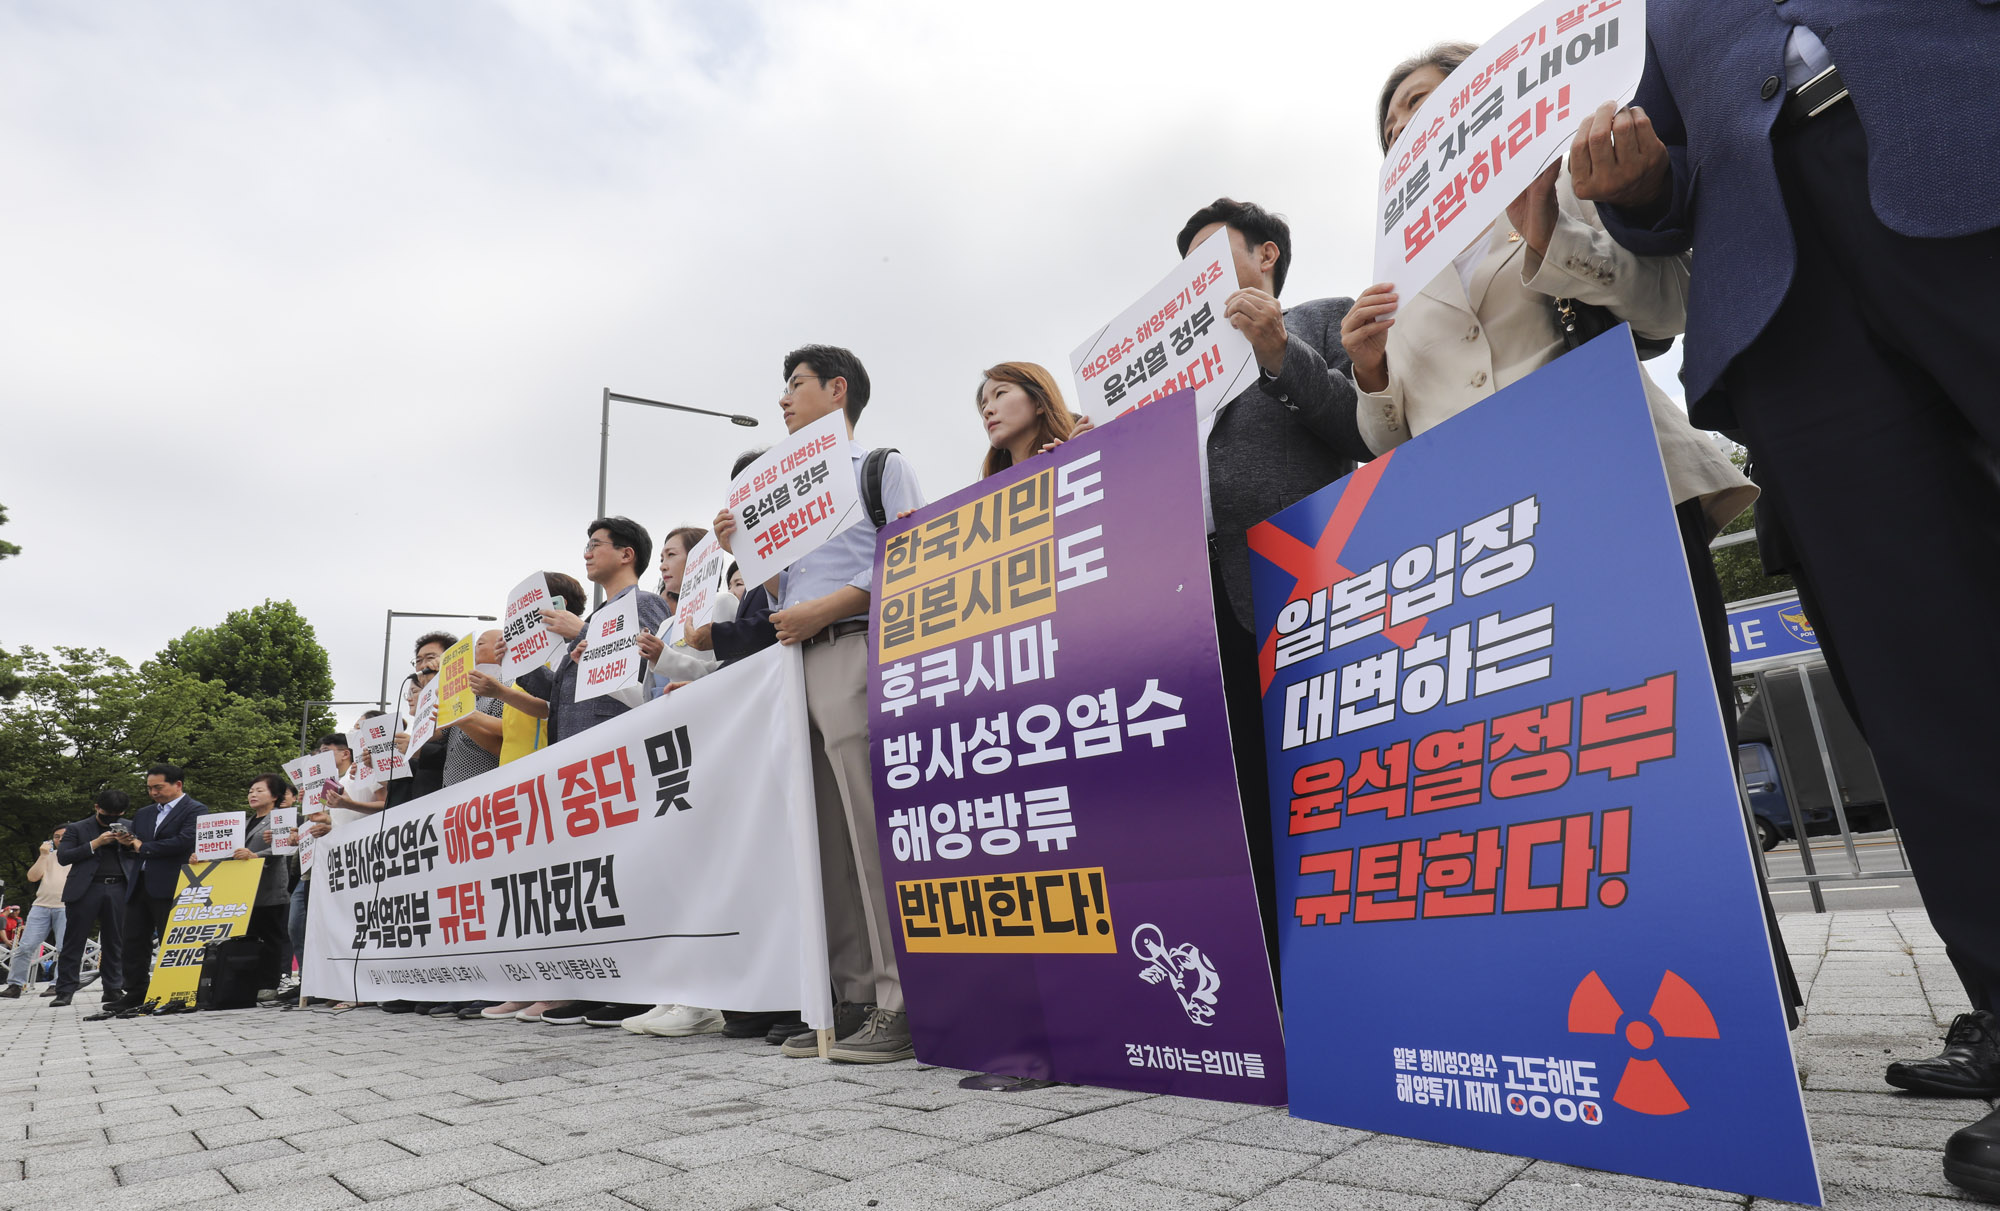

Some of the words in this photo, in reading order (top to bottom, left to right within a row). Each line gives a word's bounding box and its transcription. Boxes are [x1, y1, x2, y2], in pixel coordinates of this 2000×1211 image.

[1384, 116, 1445, 195] 핵오염수
[1450, 25, 1546, 118] 해양투기
[1384, 159, 1431, 236] 일본
[1438, 85, 1504, 172] 자국
[1517, 17, 1620, 99] 내에
[1403, 84, 1572, 264] 보관하라!
[1081, 336, 1135, 391] 핵오염수
[1135, 287, 1192, 344] 해양투기
[1192, 260, 1224, 296] 방조
[1103, 341, 1169, 407] 윤석열
[1169, 301, 1215, 356] 정부
[1115, 344, 1224, 420] 한다!
[729, 482, 751, 509] 일본
[753, 465, 777, 494] 입장
[780, 433, 837, 474] 대변하는
[742, 483, 791, 530] 윤석열
[793, 460, 830, 496] 정부
[754, 491, 835, 560] 규탄한다!
[886, 450, 1104, 585] 한국시민도
[517, 589, 543, 610] 대변하는
[881, 524, 1108, 650] 일본시민도
[1273, 493, 1541, 672] 일본입장
[503, 617, 526, 642] 윤석열
[524, 607, 543, 629] 정부
[510, 630, 549, 664] 규탄한다!
[601, 614, 624, 637] 일본을
[587, 658, 627, 685] 제소하라!
[880, 618, 1059, 717] 후쿠시마
[1281, 603, 1555, 752] 대변하는
[883, 678, 1187, 790] 방사성오염수
[1287, 670, 1678, 837] 윤석열정부
[198, 840, 232, 854] 규탄한다!
[215, 828, 233, 839] 정부
[327, 846, 344, 893] 일본
[344, 813, 439, 889] 방사성오염수
[443, 774, 556, 866] 해양투기
[557, 746, 640, 839] 중단
[644, 725, 693, 819] 및
[888, 785, 1077, 862] 해양방류
[176, 885, 213, 905] 일본
[351, 890, 432, 950] 윤석열정부
[437, 880, 487, 946] 규탄
[490, 854, 626, 939] 기자회견
[898, 871, 1110, 938] 반대한다!
[1294, 806, 1633, 927] 규탄한다!
[166, 923, 234, 944] 해양투기
[173, 902, 248, 922] 방사성오염수
[535, 961, 562, 981] 용산
[557, 958, 608, 980] 대통령실
[602, 957, 621, 978] 앞
[1124, 1043, 1265, 1079] 정치하는엄마들
[1393, 1047, 1418, 1070] 일본
[1419, 1049, 1499, 1079] 방사성오염수
[1395, 1073, 1461, 1110] 해양투기
[1463, 1080, 1502, 1115] 저지
